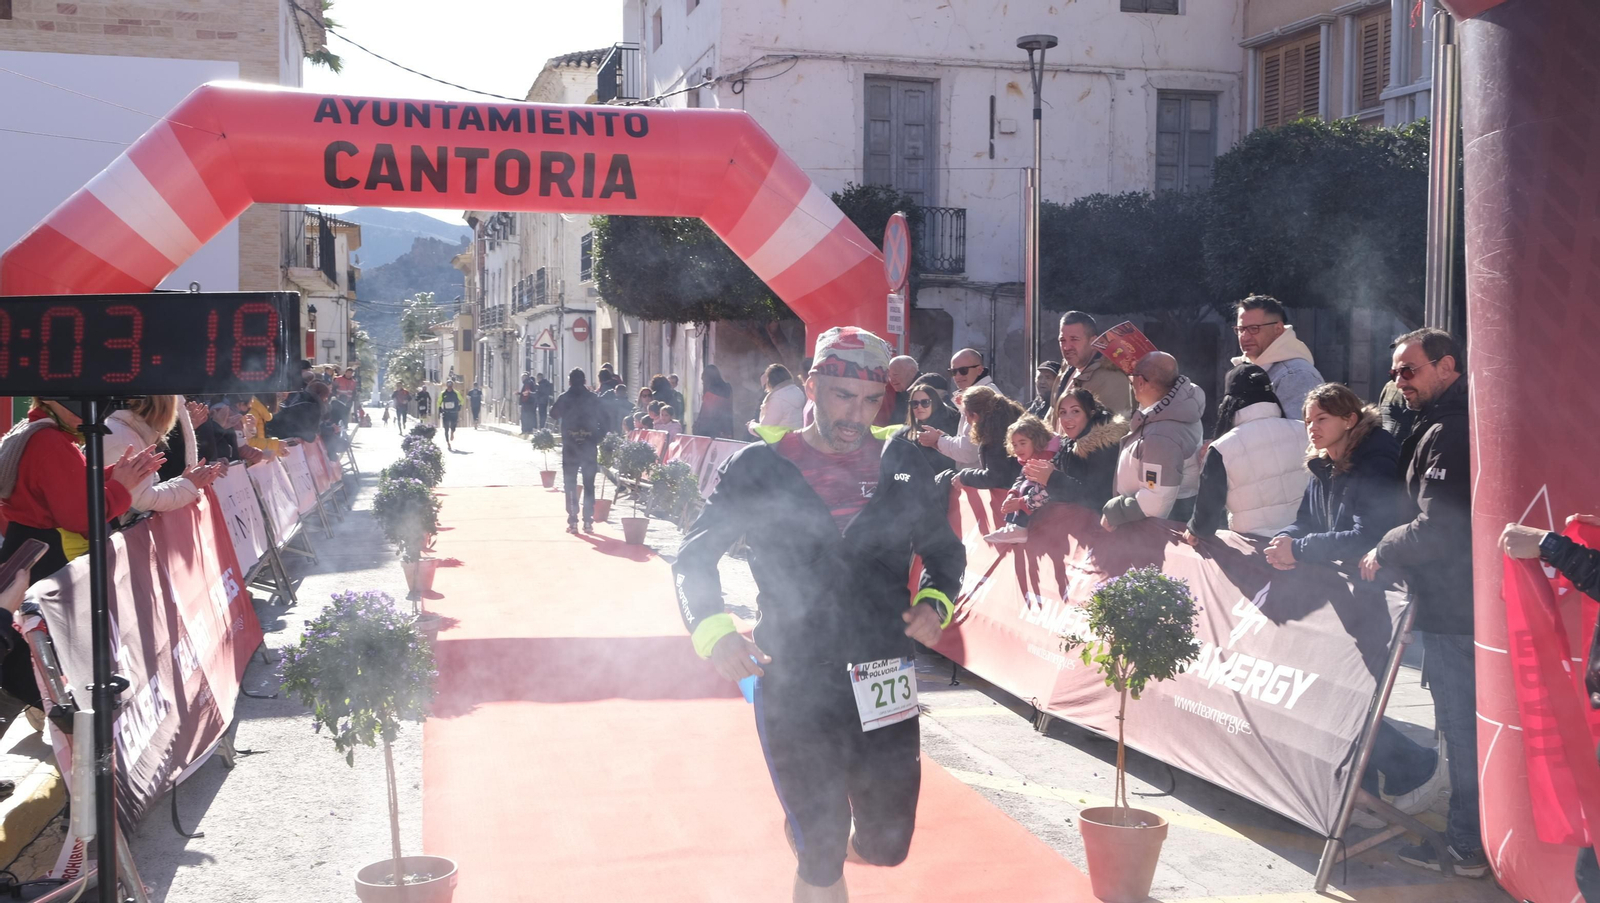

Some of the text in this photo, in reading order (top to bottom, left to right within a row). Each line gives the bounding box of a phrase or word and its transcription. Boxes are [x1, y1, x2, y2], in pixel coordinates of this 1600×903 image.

[313, 97, 649, 138] AYUNTAMIENTO
[323, 140, 637, 199] CANTORIA
[1019, 591, 1103, 642] TEAMER
[870, 674, 911, 709] 273
[1177, 638, 1320, 710] AMERGY
[113, 670, 174, 772] TEAMERG
[1174, 694, 1252, 735] www.teamergy.es
